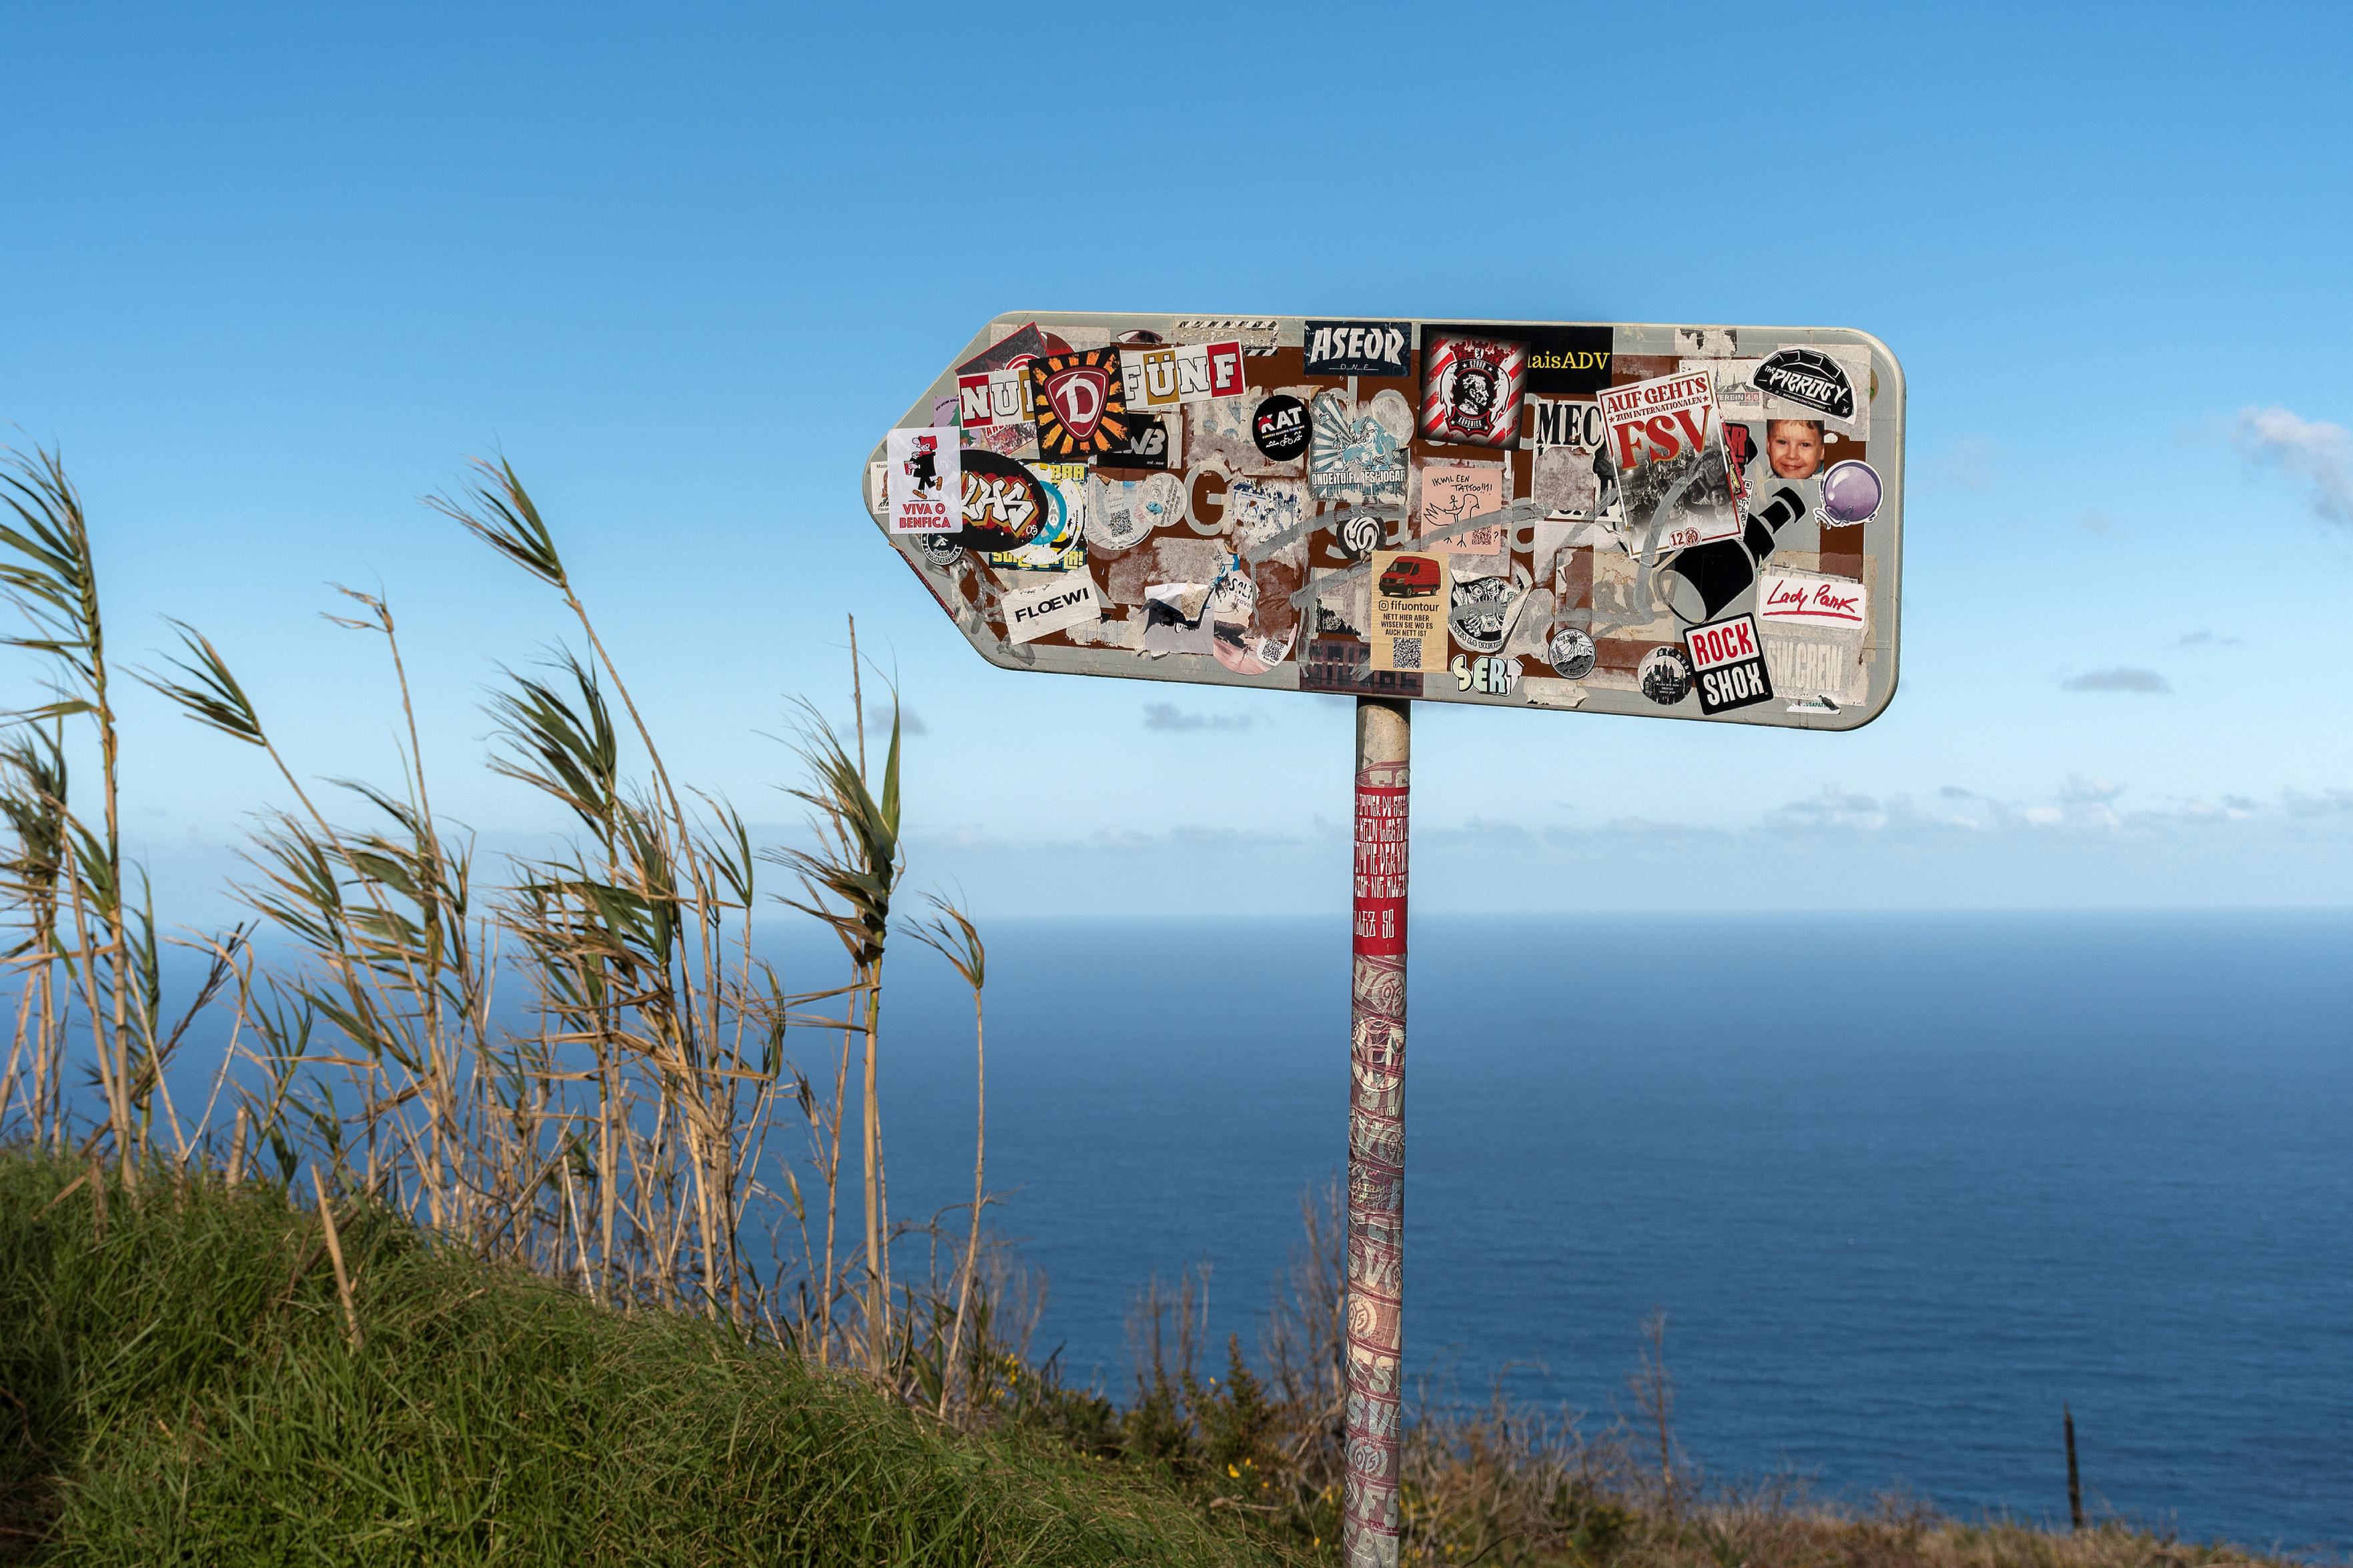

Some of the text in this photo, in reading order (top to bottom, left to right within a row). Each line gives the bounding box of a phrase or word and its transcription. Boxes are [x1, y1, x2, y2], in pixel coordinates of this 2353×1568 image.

[1607, 376, 1708, 414] AUF GEHTS
[1615, 396, 1702, 422] ZUM INTERNATIONALEN
[1612, 404, 1714, 470] FSV
[1456, 475, 1470, 483] EEN
[902, 503, 946, 516] VIVA O
[899, 516, 951, 529] BENFICA
[1015, 587, 1090, 623] FLOEWI
[1391, 600, 1440, 612] fifuontour
[1385, 628, 1401, 636] AUCH
[1418, 629, 1427, 637] IST
[1404, 621, 1414, 629] SIE
[1426, 622, 1434, 630] ES
[1466, 636, 1477, 646] LA
[1692, 622, 1754, 666] ROCK
[1703, 662, 1765, 706] SHOX
[1382, 908, 1394, 939] SC
